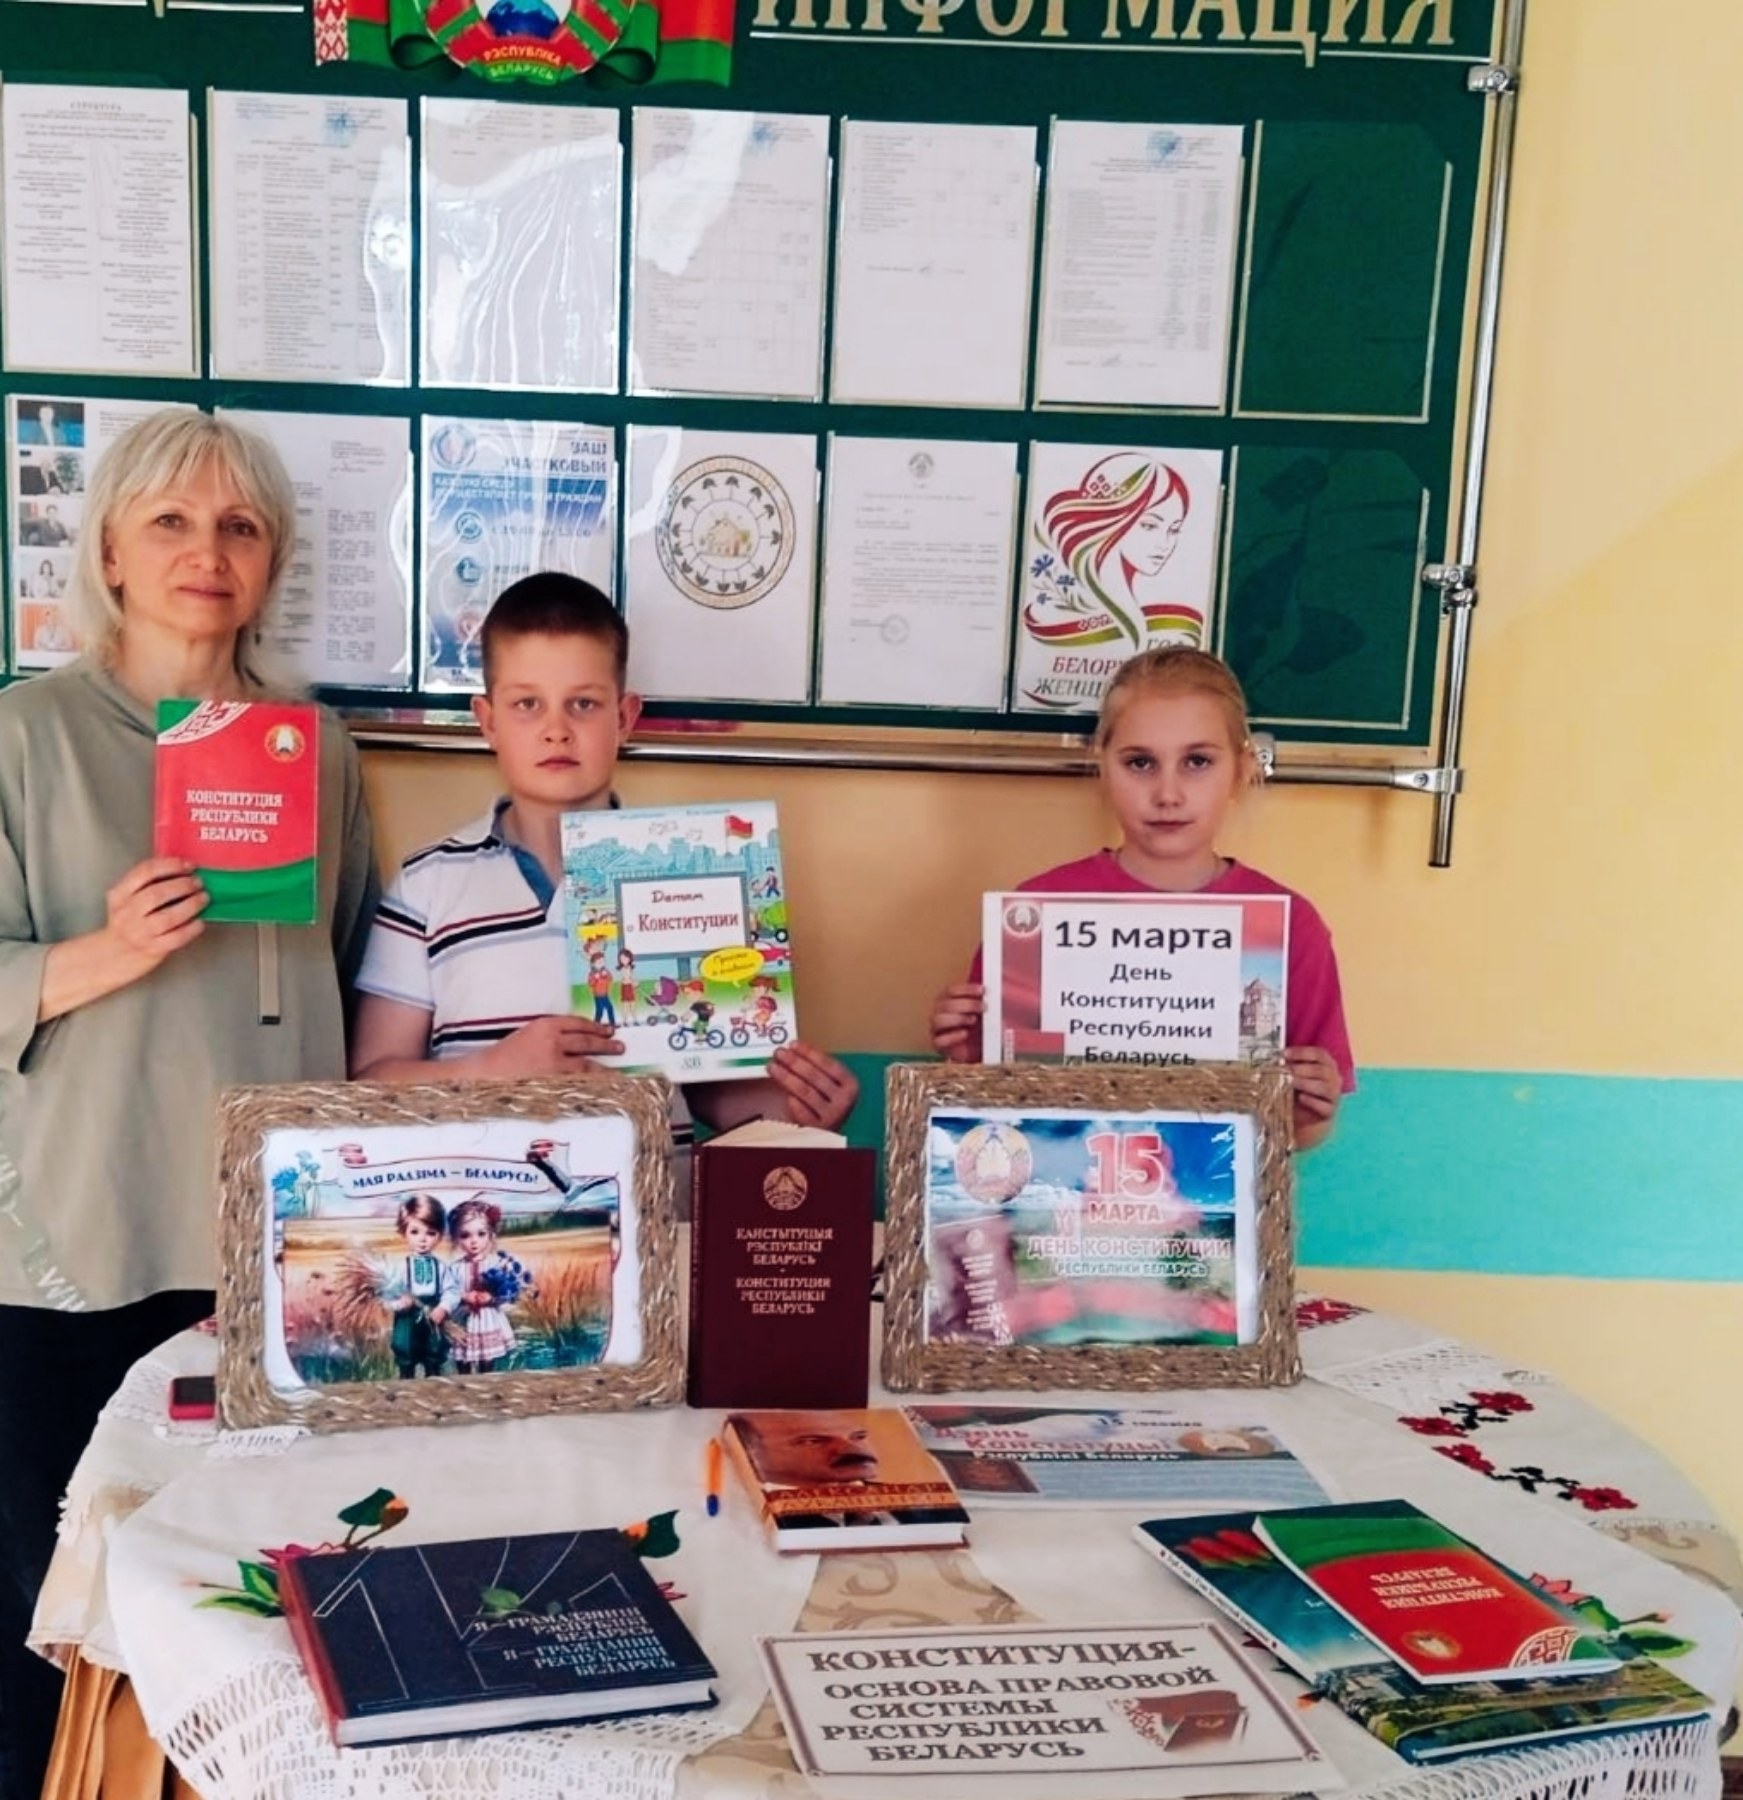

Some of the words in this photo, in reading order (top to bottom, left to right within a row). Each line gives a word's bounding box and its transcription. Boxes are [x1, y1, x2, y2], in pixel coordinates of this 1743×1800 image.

[490, 62, 554, 80] БЕЛАРУСЬ
[503, 456, 607, 474] ЧАКОВЫЙ
[186, 789, 283, 808] КОНСТИТУЦИЯ
[190, 808, 279, 825] РЕСПУБЛИКИ
[200, 826, 269, 843] БЕЛАРУСЬ
[651, 889, 704, 904] Детям
[638, 912, 739, 933] Конституции
[1054, 920, 1098, 948] 15
[1111, 927, 1233, 954] марта
[1109, 963, 1173, 983] День
[1060, 991, 1215, 1012] Конституции
[1069, 1018, 1213, 1040] Республики
[1084, 1046, 1197, 1067] Беларусь
[1087, 1132, 1164, 1197] 15
[352, 1175, 384, 1189] МАЯ
[386, 1168, 447, 1183] РАДЗІМА
[464, 1168, 539, 1183] БЕЛАРУСЬ!
[1090, 1203, 1162, 1223] МАРТА
[736, 1228, 834, 1240] КАНСТЫТУЦЫЯ
[746, 1241, 823, 1253] РЭСПУБЛІКІ
[1028, 1237, 1081, 1259] ДЕНЬ
[1082, 1238, 1231, 1260] КОНСТИТУЦИИ
[753, 1254, 816, 1265] БЕЛАРУСЬ
[1057, 1262, 1140, 1275] РЕСПУБЛИКИ
[1143, 1262, 1208, 1276] БЕЛАРУСЬ
[736, 1277, 831, 1288] КОНСТИТУЦИЯ
[741, 1290, 826, 1301] РЕСПУБЛИКИ
[752, 1303, 815, 1314] БЕЛАРУСЬ
[1369, 1566, 1457, 1582] БЕЛАРУСЬ
[556, 1626, 655, 1643] БЕЛАРУСЬ
[534, 1646, 668, 1669] РЕСПУБЛИКИ
[807, 1640, 1196, 1672] КОНСТИТУЦИЯ-
[574, 1657, 676, 1677] БЕЛАРУСЬ
[823, 1678, 994, 1699] ОСНОВА
[996, 1665, 1220, 1693] ПРАВОВОЙ
[849, 1698, 1060, 1720] СИСТЕМЫ
[819, 1717, 1110, 1741] РЕСПУБЛИКИ
[865, 1741, 1086, 1762] БЕЛАРУСЬ
